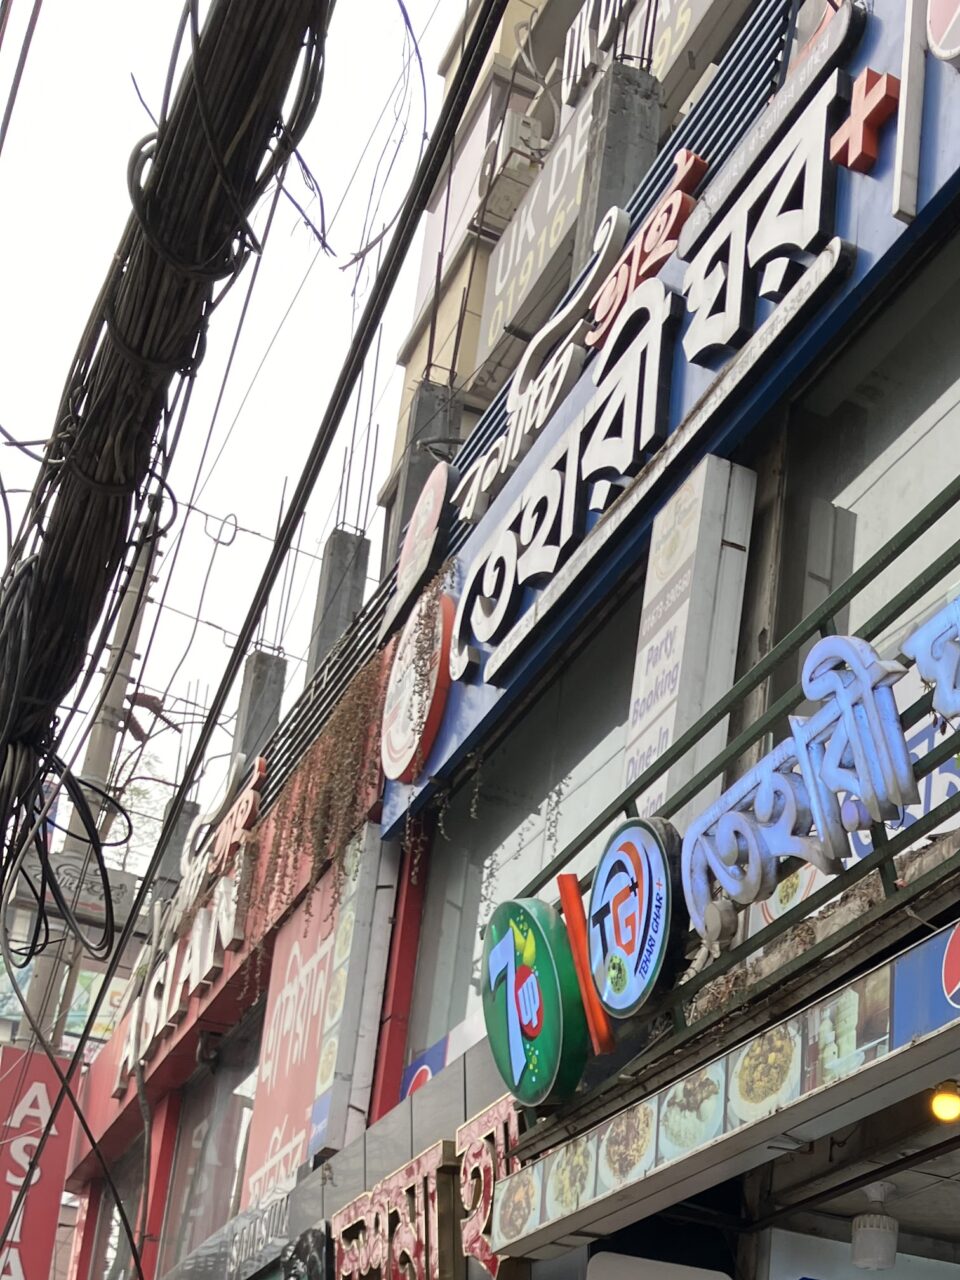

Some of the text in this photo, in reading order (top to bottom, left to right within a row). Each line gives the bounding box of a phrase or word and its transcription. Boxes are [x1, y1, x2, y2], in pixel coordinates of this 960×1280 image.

[452, 278, 680, 682] তেহারী
[681, 67, 848, 368] ঘর
[638, 892, 664, 980] TEHARI GHAR
[681, 636, 920, 943] তেহারী
